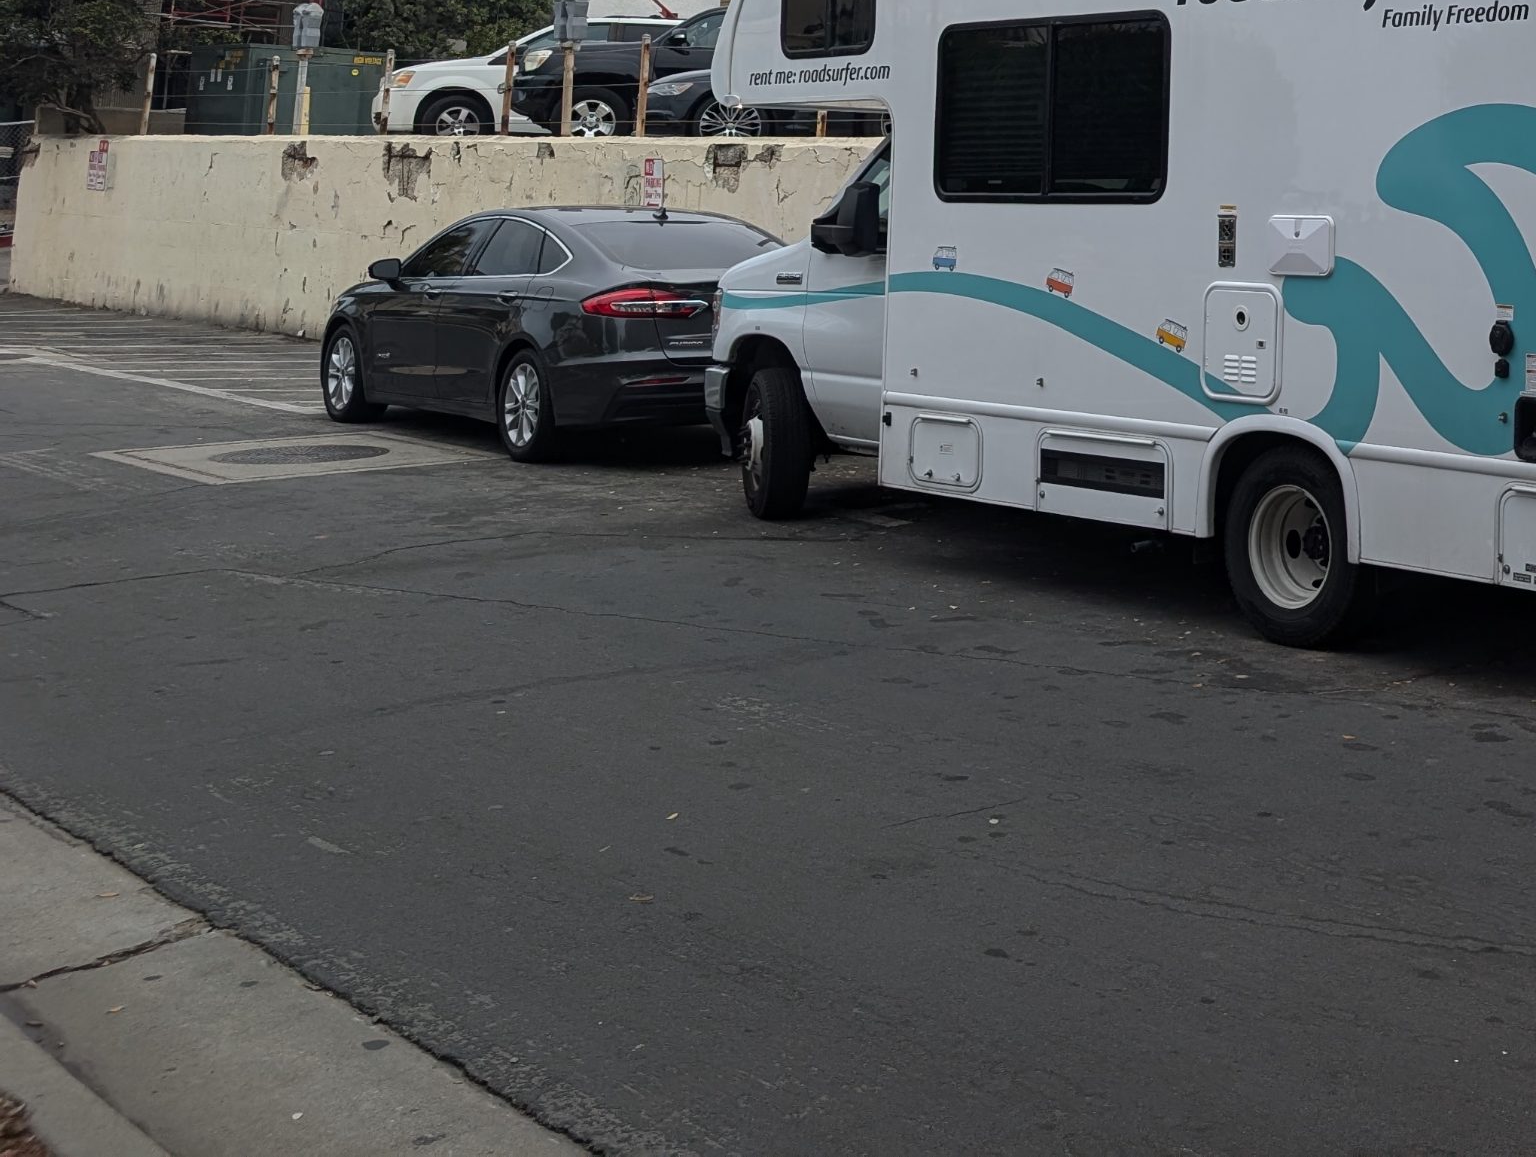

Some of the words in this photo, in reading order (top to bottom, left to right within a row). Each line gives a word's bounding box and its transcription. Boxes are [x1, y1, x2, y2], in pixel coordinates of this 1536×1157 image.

[1382, 4, 1443, 31] Family
[1445, 0, 1529, 25] Freedom
[749, 69, 773, 86] rent
[775, 70, 797, 84] me:
[798, 62, 891, 86] roadsurfer.com
